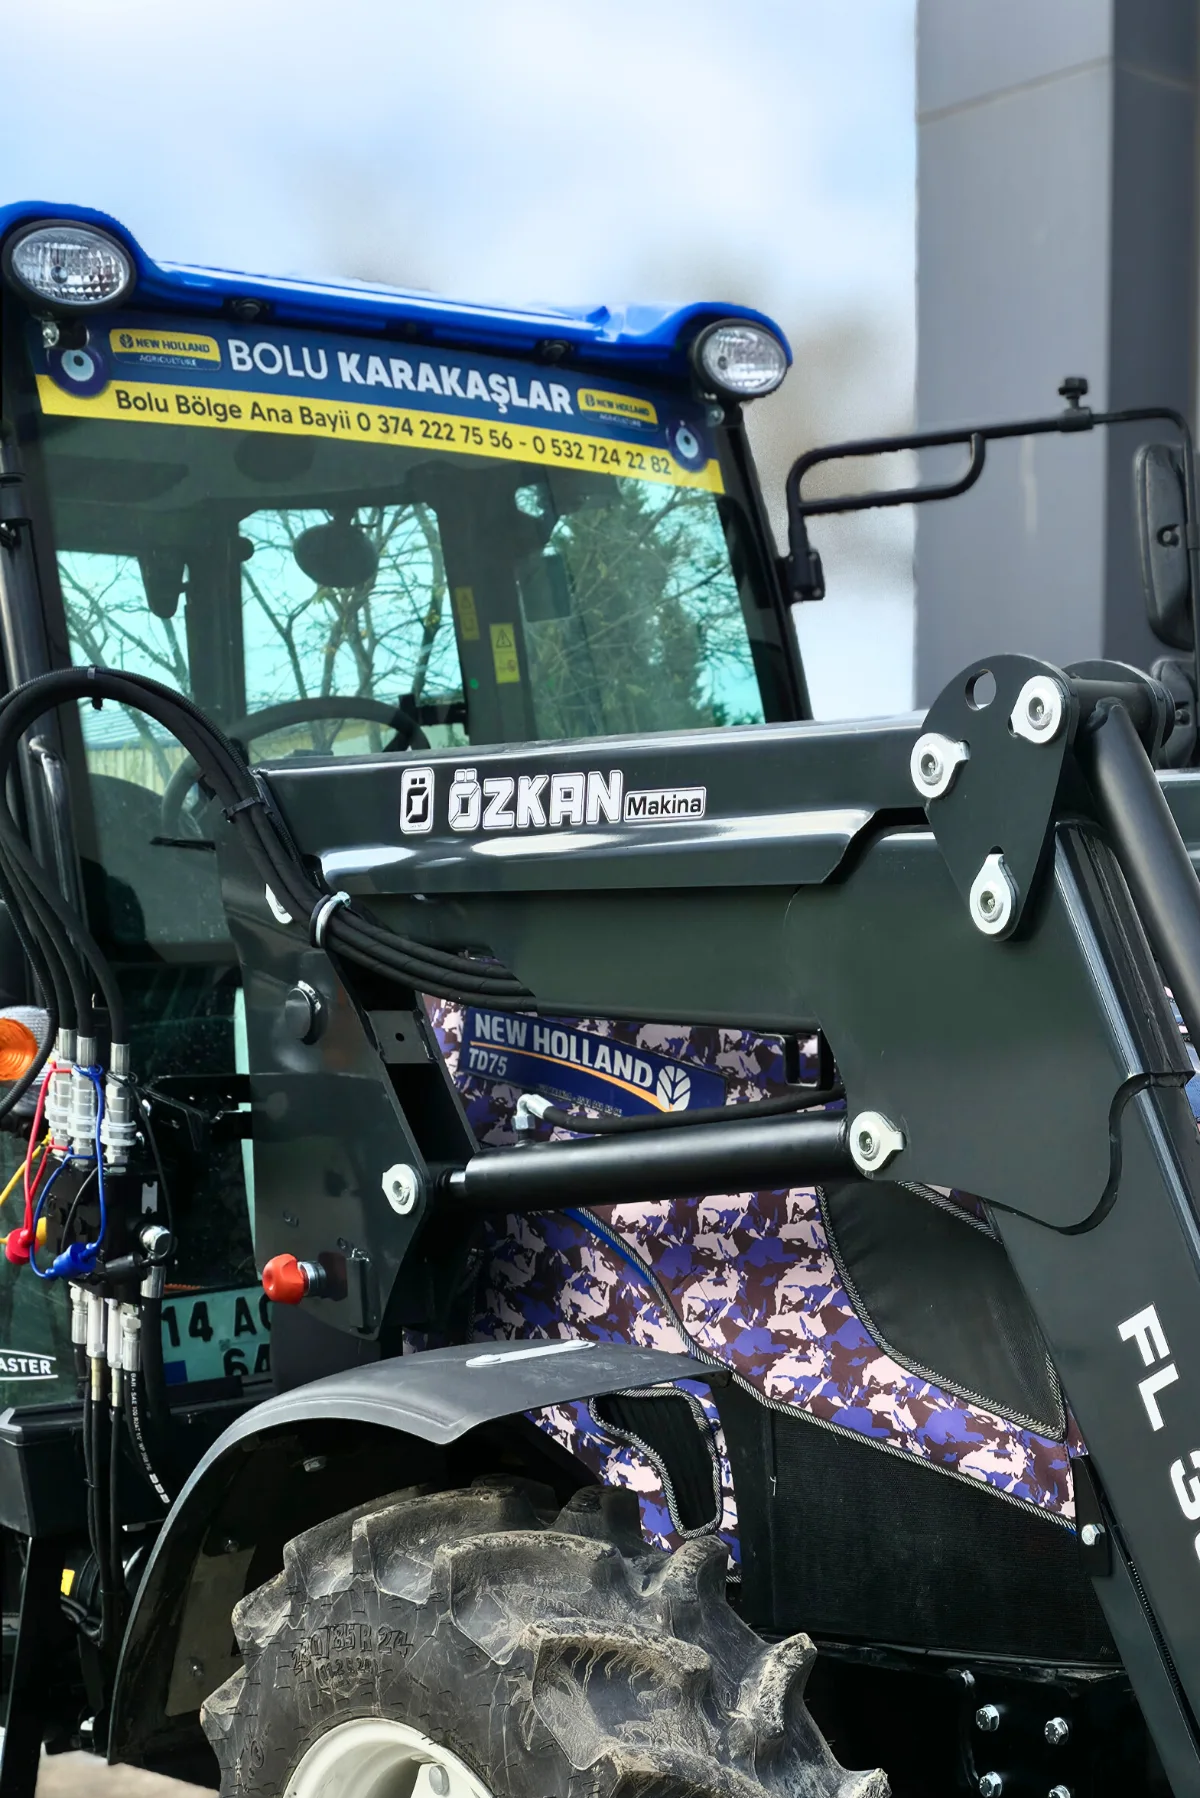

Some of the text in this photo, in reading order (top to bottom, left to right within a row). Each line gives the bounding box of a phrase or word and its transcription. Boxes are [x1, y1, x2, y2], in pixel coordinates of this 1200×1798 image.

[136, 338, 210, 353] NEW HOLLAND
[227, 338, 574, 415] BOLU KARAKAŞLAR
[115, 389, 169, 414] Bolu
[175, 395, 242, 423] Bölge
[250, 401, 293, 424] Ana
[299, 405, 351, 433] Bayii
[357, 412, 371, 432] 0
[377, 415, 414, 437] 374
[419, 420, 456, 442] 222
[460, 425, 484, 446] 75
[489, 429, 513, 449] 56
[533, 435, 545, 455] 0
[551, 438, 584, 460] 532
[588, 444, 621, 466] 724
[626, 450, 646, 470] 22
[651, 455, 672, 476] 82
[449, 768, 702, 832] ÖZKAN Makina
[468, 1048, 509, 1077] TD75
[475, 1013, 653, 1088] NEW HOLLAND
[161, 1301, 214, 1348] 14
[1117, 1303, 1179, 1432] FL
[378, 1624, 414, 1658] 24
